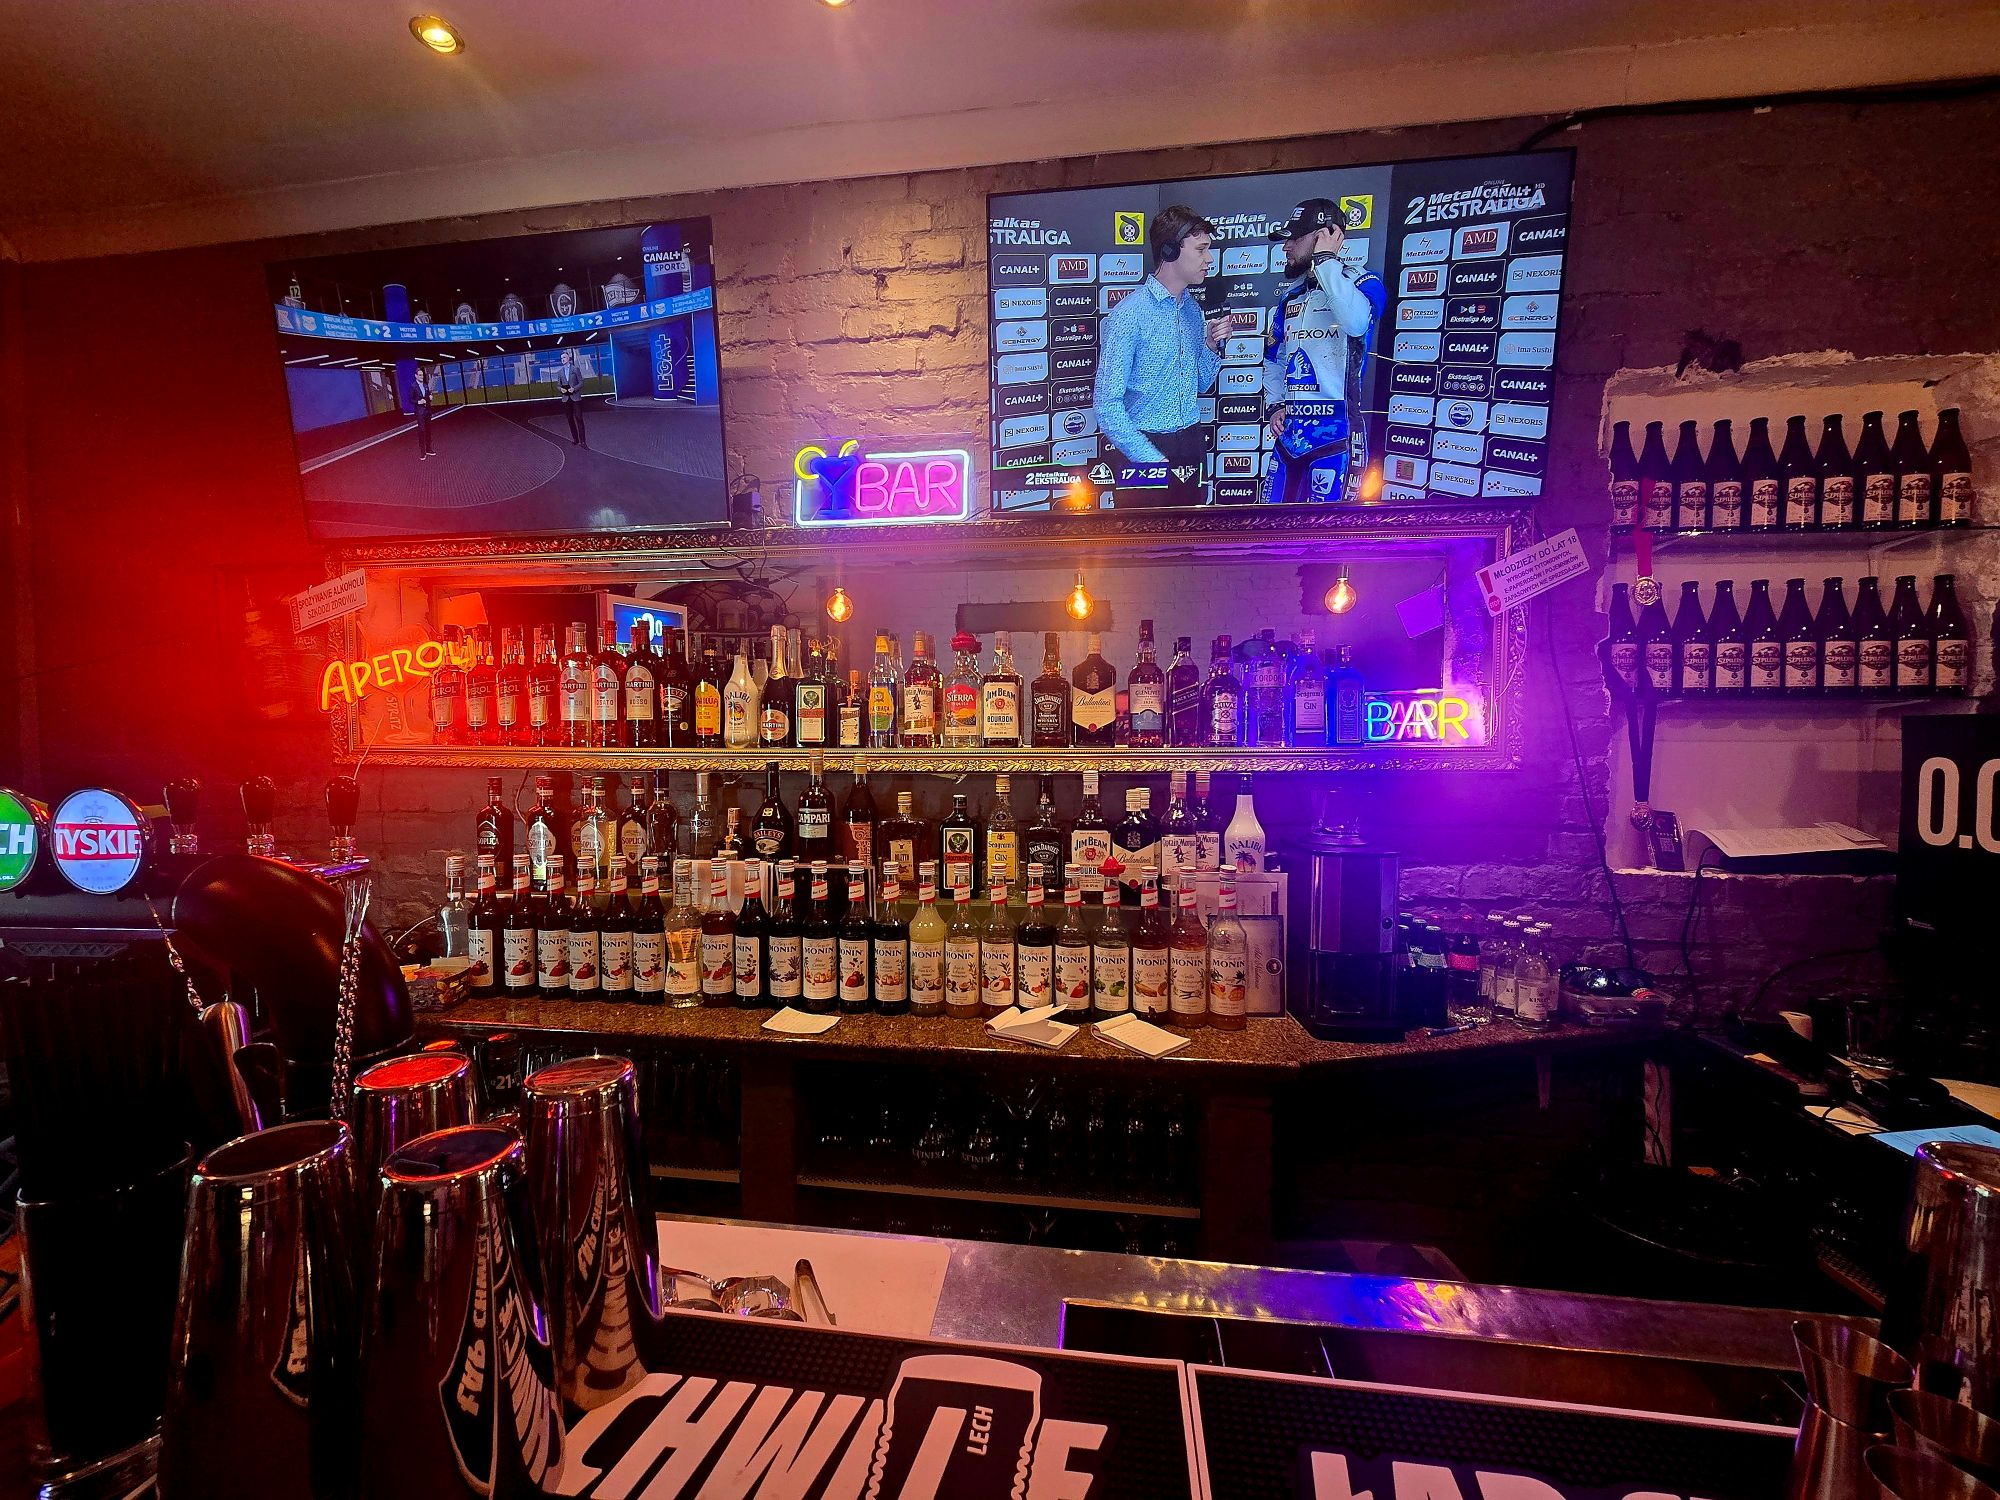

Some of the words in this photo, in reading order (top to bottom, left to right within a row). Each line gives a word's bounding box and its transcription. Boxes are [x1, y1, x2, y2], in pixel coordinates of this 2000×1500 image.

[1483, 184, 1531, 198] CANAL+
[1404, 196, 1425, 225] 2
[1426, 189, 1546, 222] EKSTRALIGA
[1464, 231, 1497, 245] AMD
[643, 251, 681, 262] CANAL+
[1405, 249, 1446, 257] Metalkas
[1000, 265, 1040, 274] CANAL+
[1059, 260, 1087, 271] AMD
[1227, 262, 1264, 270] Metalkas
[1104, 269, 1139, 277] Metalkas
[1409, 272, 1437, 284] AMD
[1455, 272, 1497, 284] CANAL+
[1055, 297, 1091, 306] CANAL+
[595, 316, 604, 325] 2
[1231, 313, 1257, 324] AMD
[364, 324, 371, 336] 1
[383, 325, 392, 338] 2
[491, 327, 500, 336] 2
[1292, 329, 1339, 340] TEXOM
[1448, 343, 1489, 352] CANAL+
[1056, 358, 1092, 369] CANAL+
[1227, 375, 1254, 383] HOG
[1396, 374, 1432, 384] CANAL+
[1500, 380, 1547, 391] CANAL+
[1005, 394, 1043, 405] CANAL+
[1223, 406, 1256, 414] CANAL+
[1285, 405, 1334, 416] NEXORIS
[1508, 417, 1543, 426] NEXORIS
[1015, 426, 1045, 435] NEXORIS
[1391, 435, 1426, 446] CANAL+
[1450, 444, 1478, 453] TEXOM
[1006, 455, 1044, 467] CANAL+
[1492, 449, 1538, 462] CANAL+
[1225, 457, 1251, 467] AMD
[1025, 473, 1035, 485] 2
[1121, 470, 1134, 479] 17
[1147, 468, 1167, 479] 25
[1035, 475, 1081, 485] EKSTRALIGA
[1445, 475, 1475, 485] NEXORIS
[855, 460, 957, 512] BAR
[1220, 489, 1253, 497] CANAL+
[1494, 551, 1538, 580] MŁODZIEŻY
[1539, 547, 1552, 559] DO
[1552, 540, 1568, 554] LAT
[1568, 535, 1577, 545] 18
[1506, 569, 1533, 584] WYROBÓW
[333, 575, 365, 598] ALKOHOLU
[1504, 586, 1540, 603] ZAPASOWYCH
[307, 603, 331, 619] SZKODZI
[321, 641, 469, 711] APEROL
[724, 691, 751, 703] MALIBU
[946, 693, 974, 702] SIERRA
[986, 691, 997, 701] JIM
[997, 687, 1015, 699] BEAM
[1296, 690, 1324, 698] Seagram's
[1034, 695, 1047, 705] JACK
[1075, 696, 1111, 706] Ballantine's
[1303, 702, 1317, 710] GIN
[987, 715, 1013, 723] BOURBON
[1367, 697, 1469, 741] BAR
[753, 829, 785, 840] BAILEYS
[55, 829, 143, 856] TYSKIE
[621, 837, 645, 845] SOPLICA
[988, 842, 1015, 850] Seagram's
[1074, 838, 1088, 851] JIM
[1088, 836, 1108, 850] BEAM
[1029, 845, 1041, 855] JACK
[1229, 840, 1264, 854] MALIBU
[994, 853, 1008, 862] GIN
[1116, 852, 1152, 864] Ballantine's
[912, 950, 941, 958] MONIN
[1019, 954, 1048, 963] MONIN
[1056, 955, 1087, 964] MONIN
[1095, 956, 1126, 965] MONIN
[1136, 958, 1168, 966] MONIN
[1171, 958, 1203, 967] MONIN
[1212, 959, 1246, 968] MONIN
[966, 1405, 993, 1455] LECH
